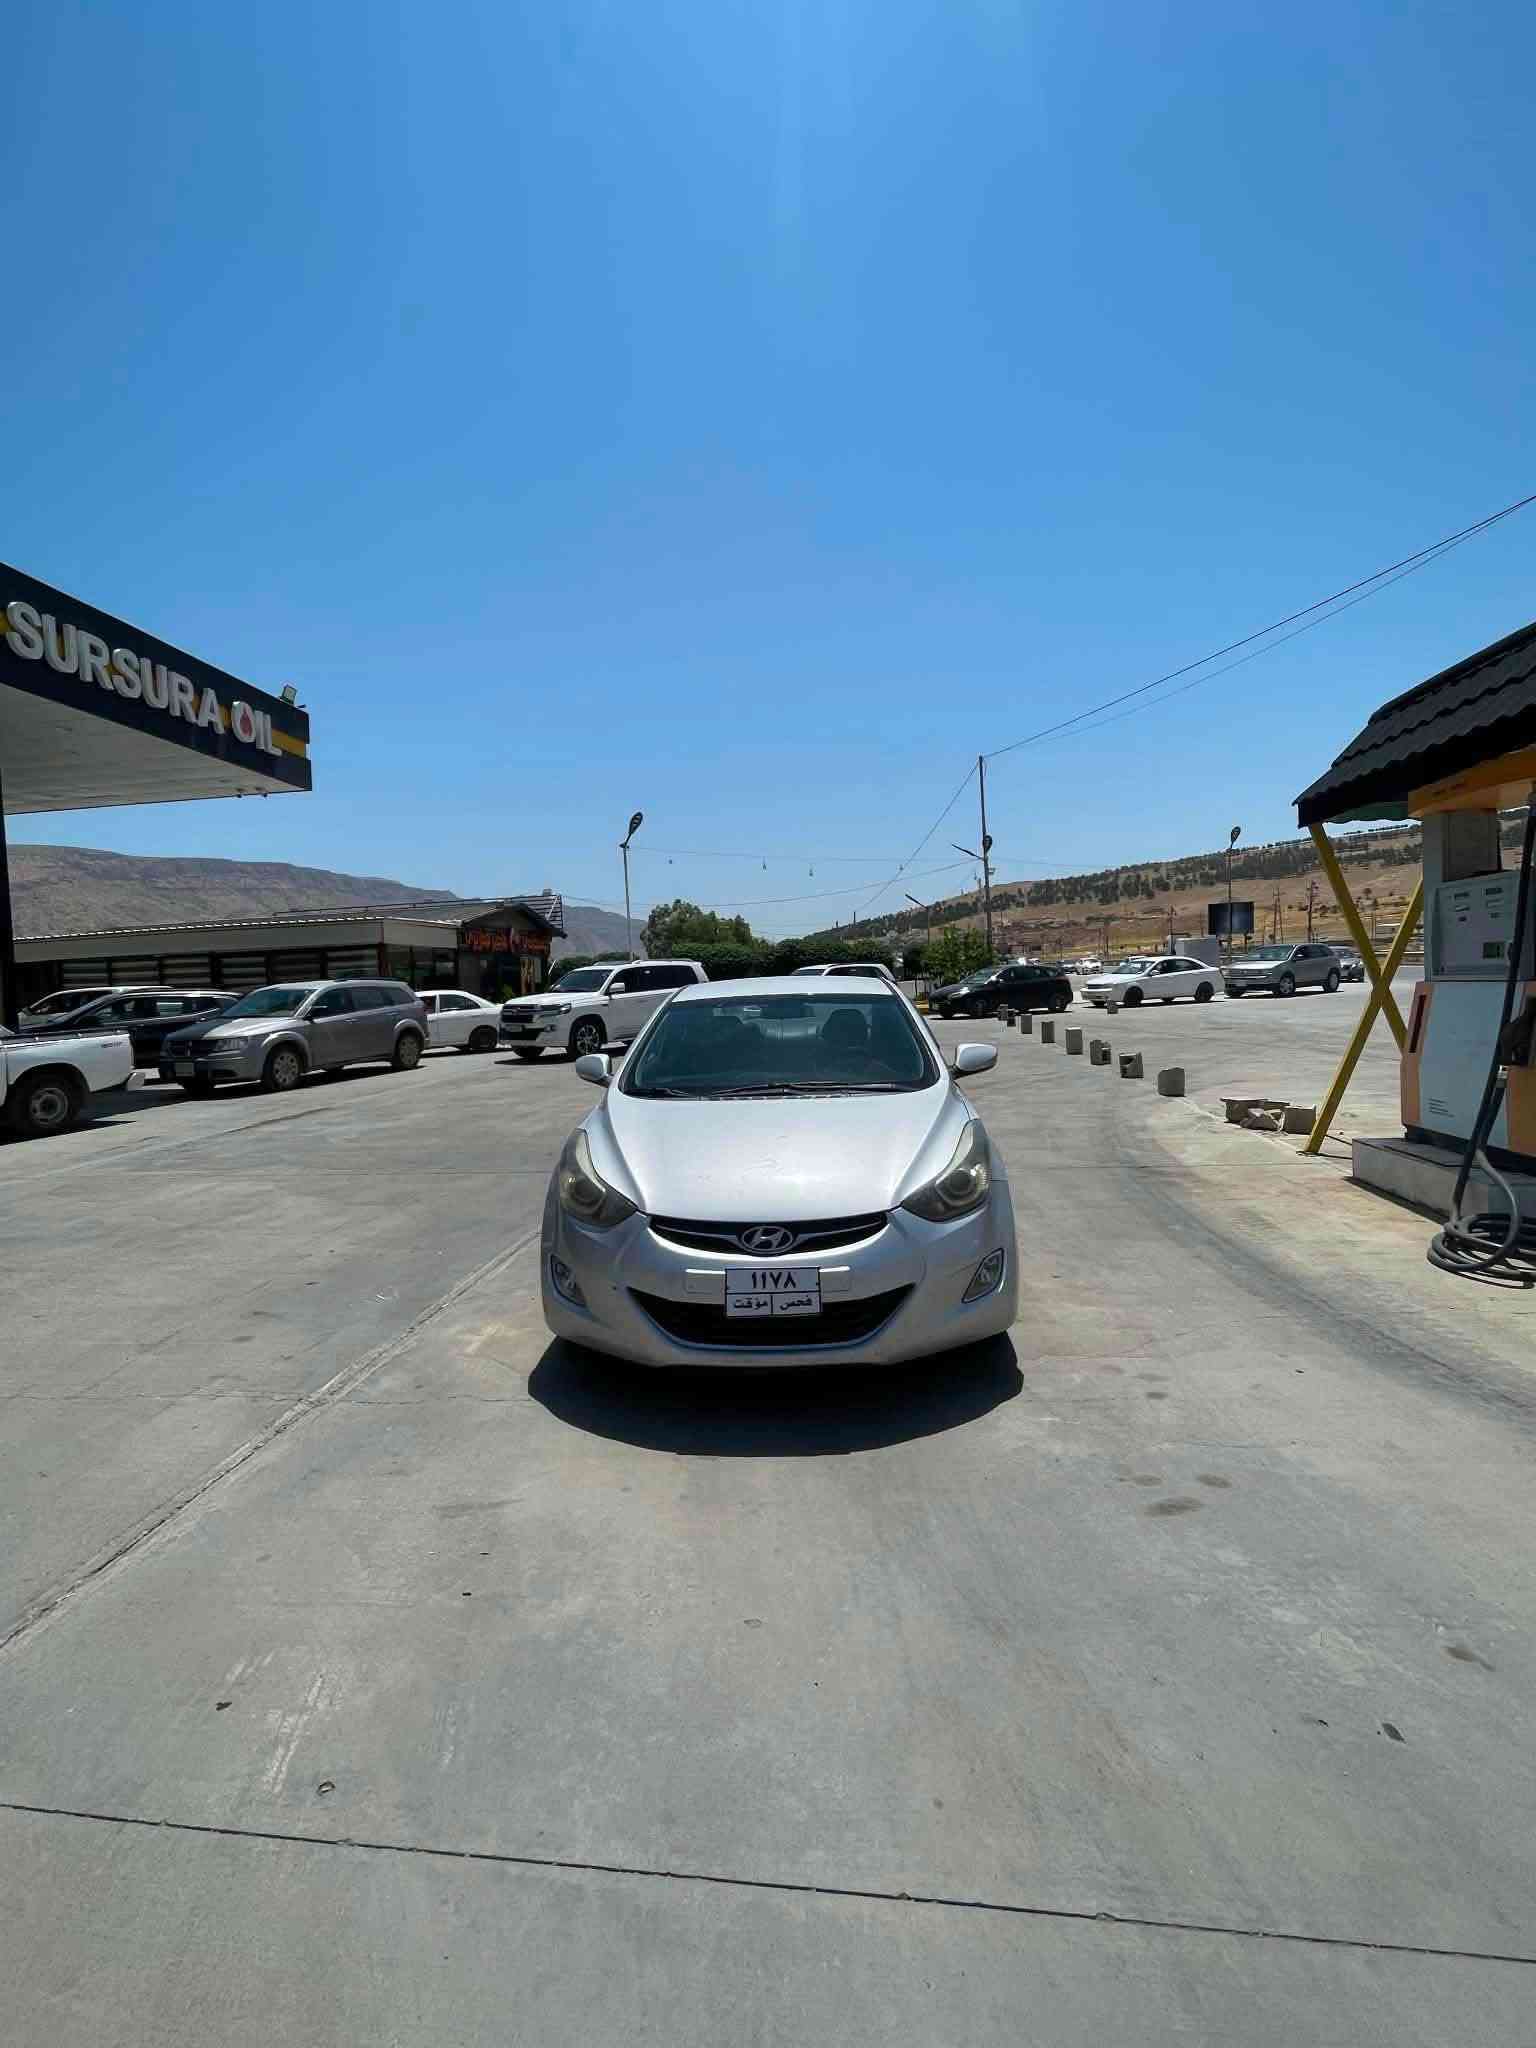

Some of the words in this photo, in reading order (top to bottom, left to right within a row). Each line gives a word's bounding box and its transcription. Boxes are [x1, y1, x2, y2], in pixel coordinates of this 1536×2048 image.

[5, 601, 225, 735] SURSURA
[231, 701, 282, 756] OIL
[751, 1271, 796, 1289] ١١٧٨
[779, 1294, 813, 1311] فحص
